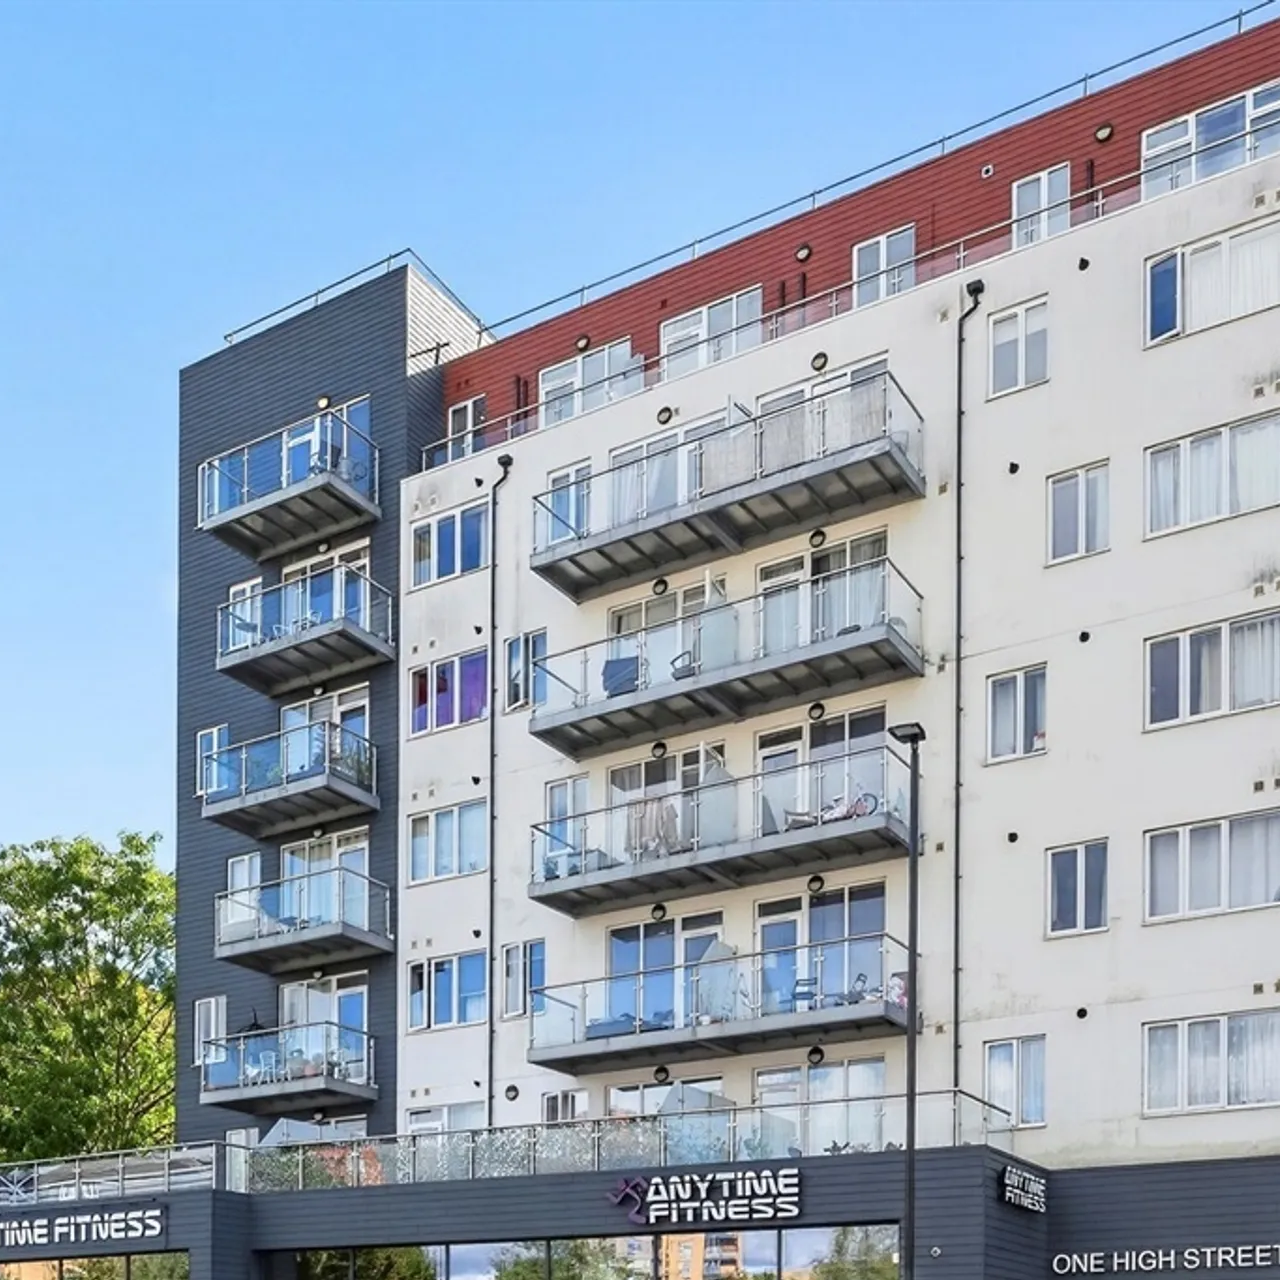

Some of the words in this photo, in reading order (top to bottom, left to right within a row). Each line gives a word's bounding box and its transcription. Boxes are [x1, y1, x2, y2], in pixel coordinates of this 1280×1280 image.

[646, 1168, 800, 1202] ANYTIME
[1004, 1165, 1046, 1197] ANYTIME
[648, 1196, 800, 1224] FITNESS
[1005, 1186, 1046, 1213] FITNESS
[54, 1209, 162, 1243] FITNESS
[1052, 1252, 1105, 1274] ONE
[1112, 1249, 1176, 1272] HIGH
